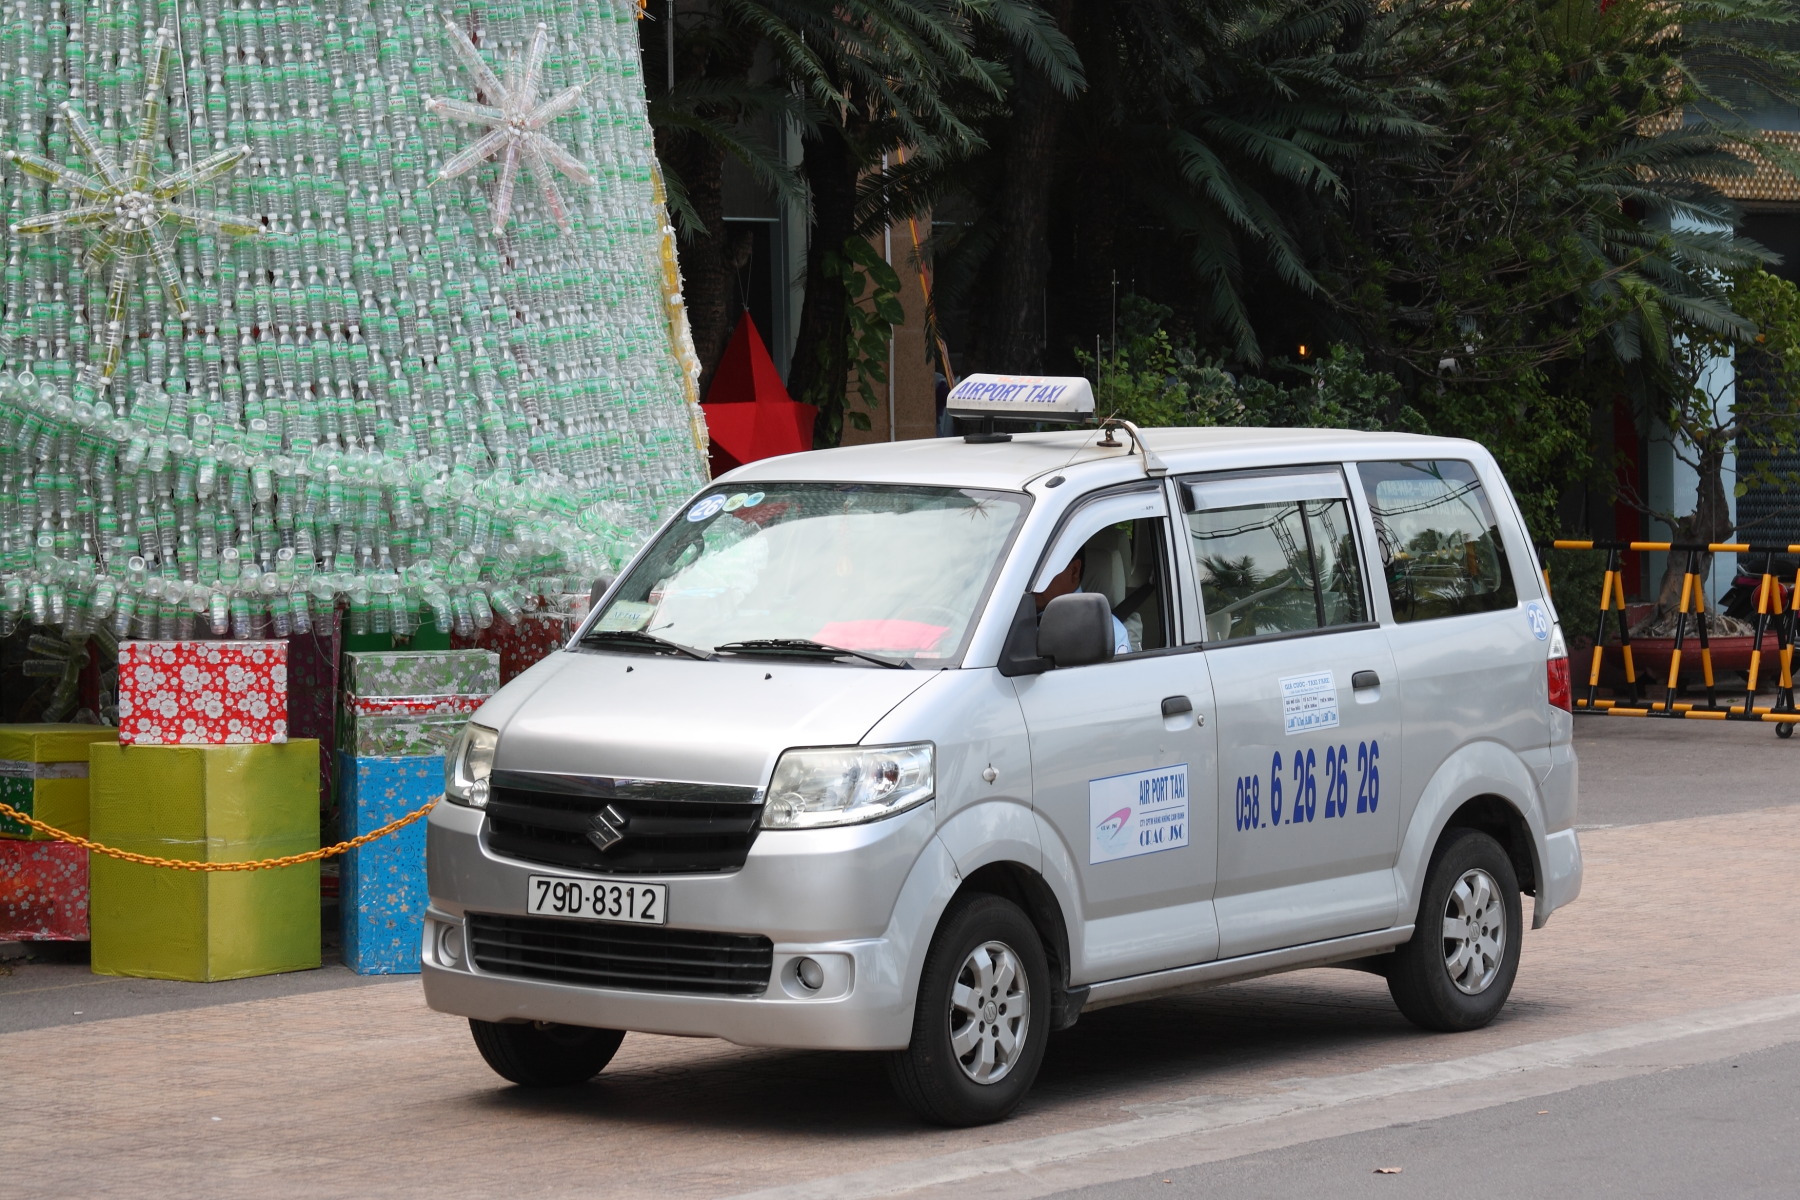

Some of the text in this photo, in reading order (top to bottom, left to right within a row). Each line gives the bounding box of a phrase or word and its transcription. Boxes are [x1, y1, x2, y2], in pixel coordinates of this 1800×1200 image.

[951, 381, 1067, 403] AIRPORT TAXI
[689, 498, 724, 517] 26
[1529, 608, 1547, 633] 26
[1139, 773, 1185, 806] AIR PORT TAXI
[1325, 744, 1348, 819] 26
[1357, 739, 1380, 814] 26
[1168, 823, 1185, 842] JSC
[536, 880, 657, 919] 79D-8312
